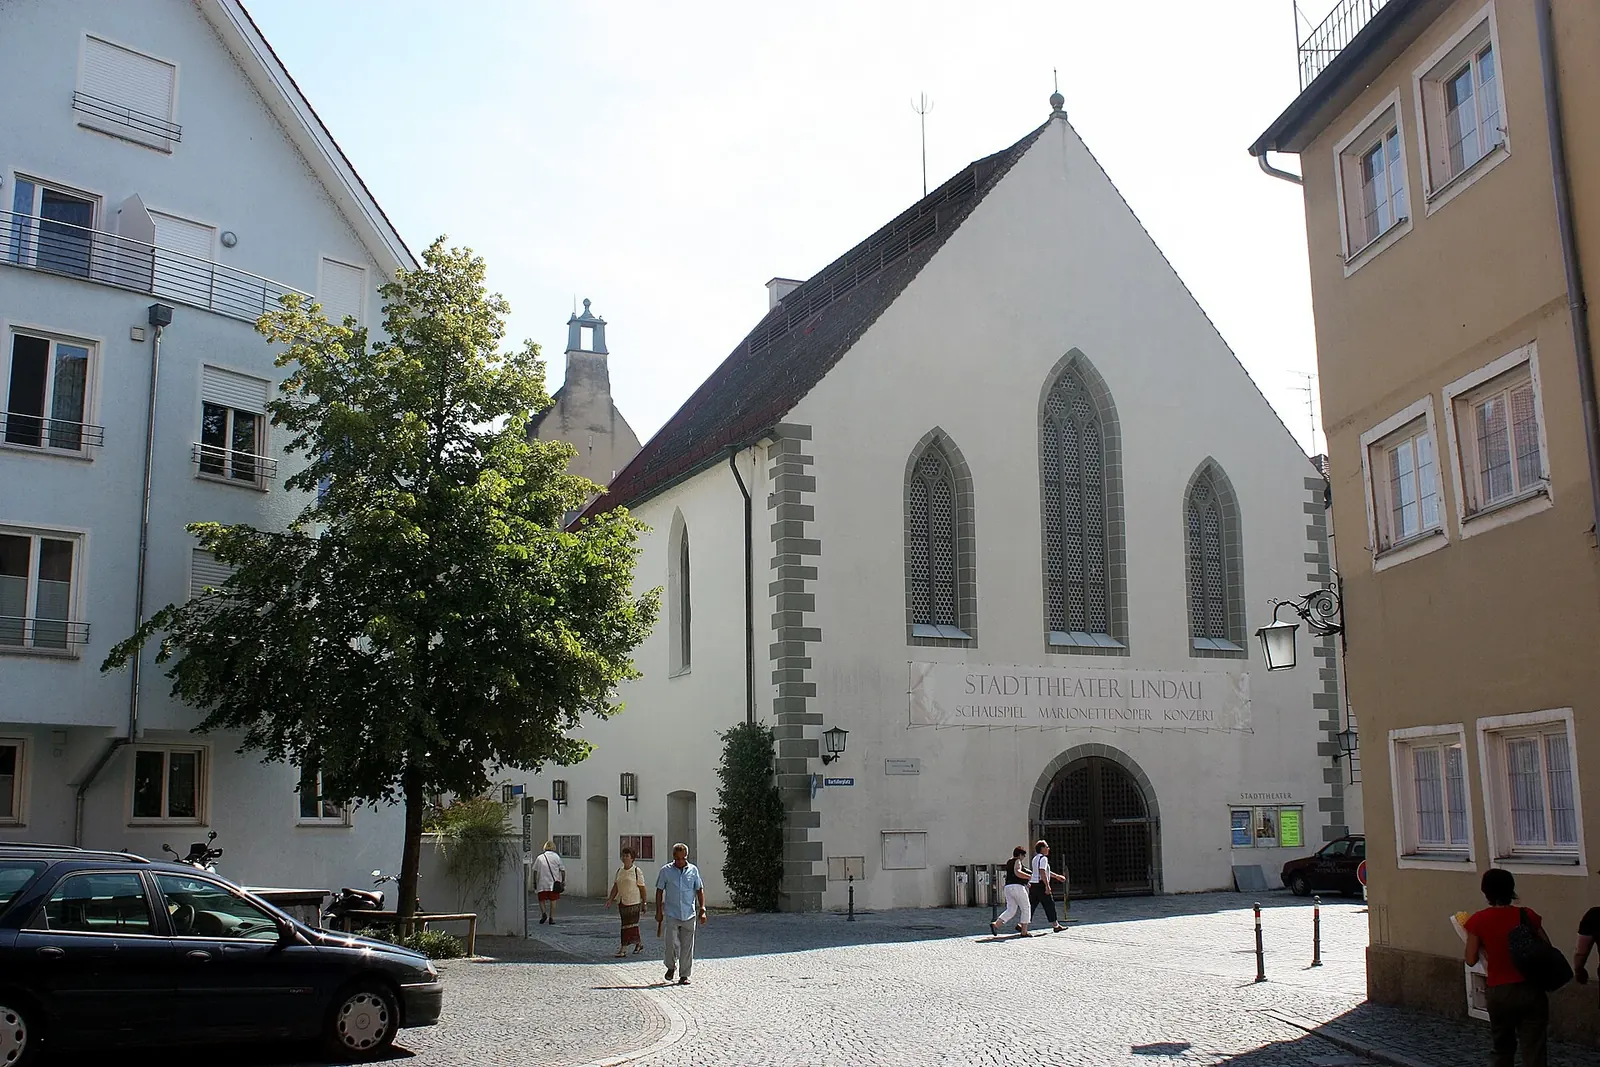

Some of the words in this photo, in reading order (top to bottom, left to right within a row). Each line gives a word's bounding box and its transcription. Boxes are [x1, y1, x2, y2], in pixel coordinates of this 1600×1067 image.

[964, 674, 1123, 699] STADTTHEATER
[1130, 679, 1203, 700] LINDAU
[955, 704, 1027, 719] SCHAUSPIEL
[1038, 706, 1153, 721] MARIONETTENOPER
[1163, 709, 1214, 721] KONZERT
[1240, 792, 1292, 800] STADTTHEATER
